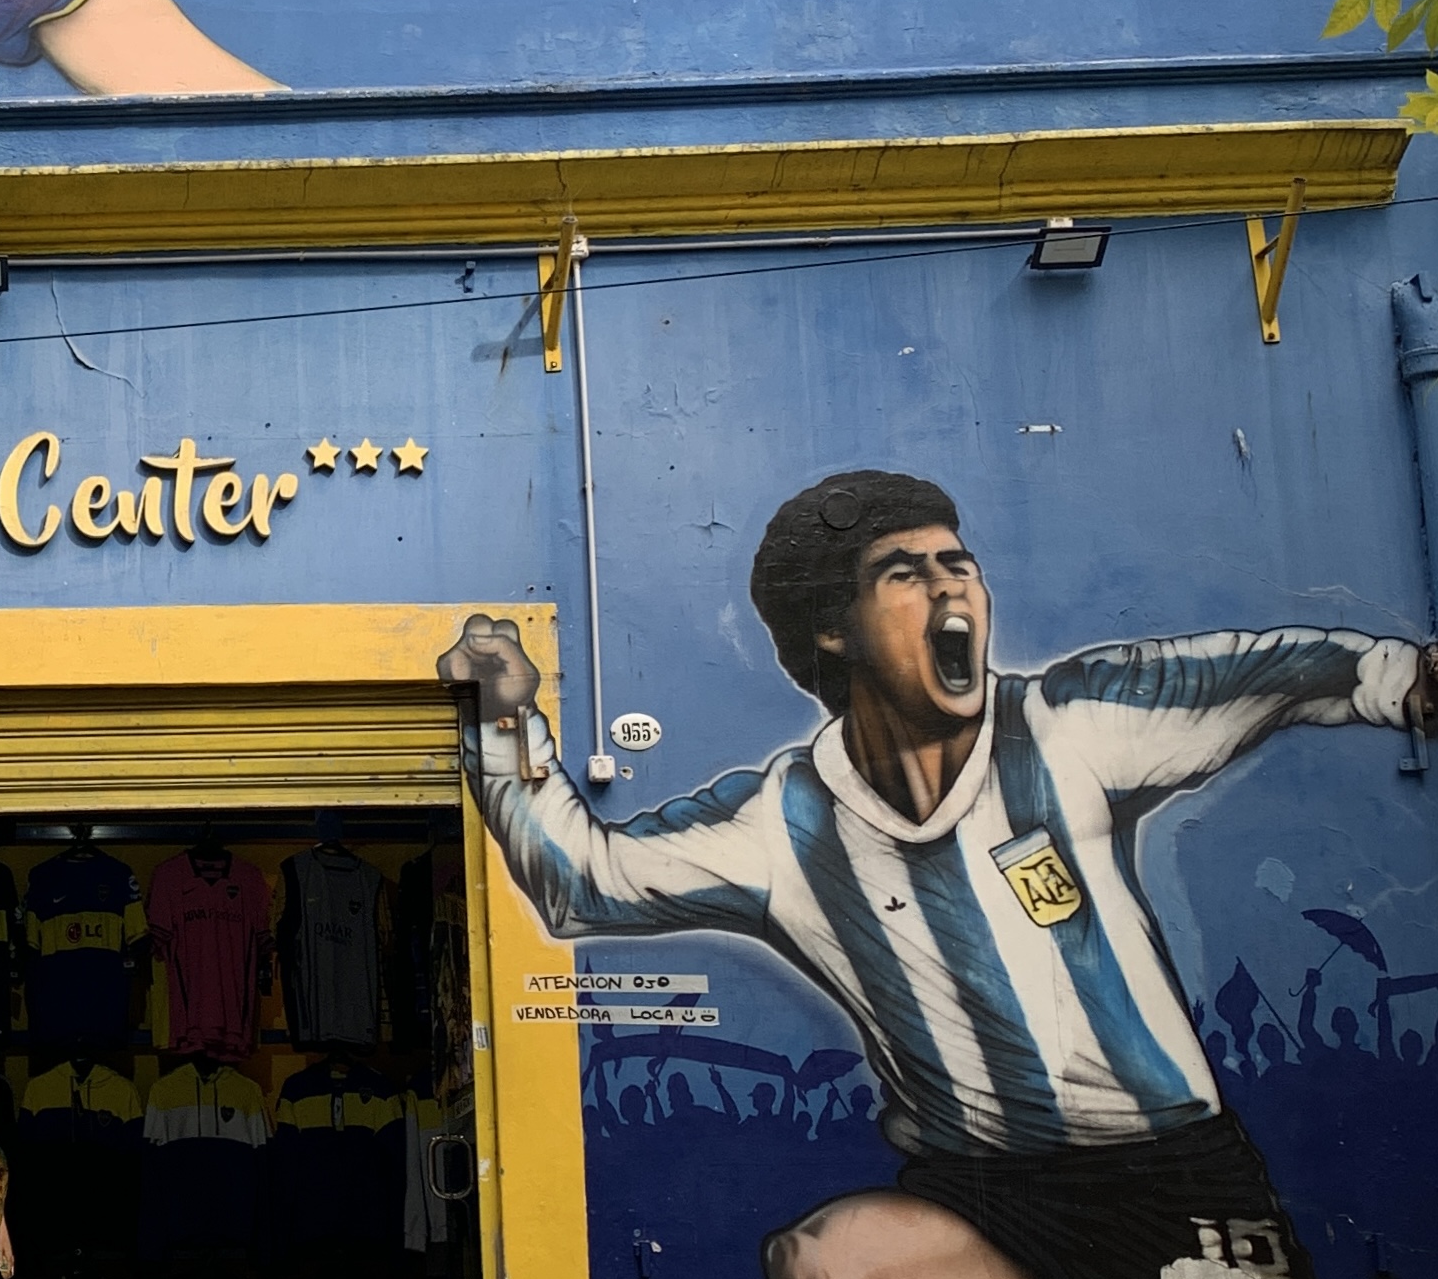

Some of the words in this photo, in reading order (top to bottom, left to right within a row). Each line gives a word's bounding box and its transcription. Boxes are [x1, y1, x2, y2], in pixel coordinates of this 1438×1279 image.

[622, 722, 651, 742] 955
[1020, 856, 1076, 911] AFA
[516, 1007, 611, 1022] VENDEDORA
[631, 1009, 674, 1021] LOCA
